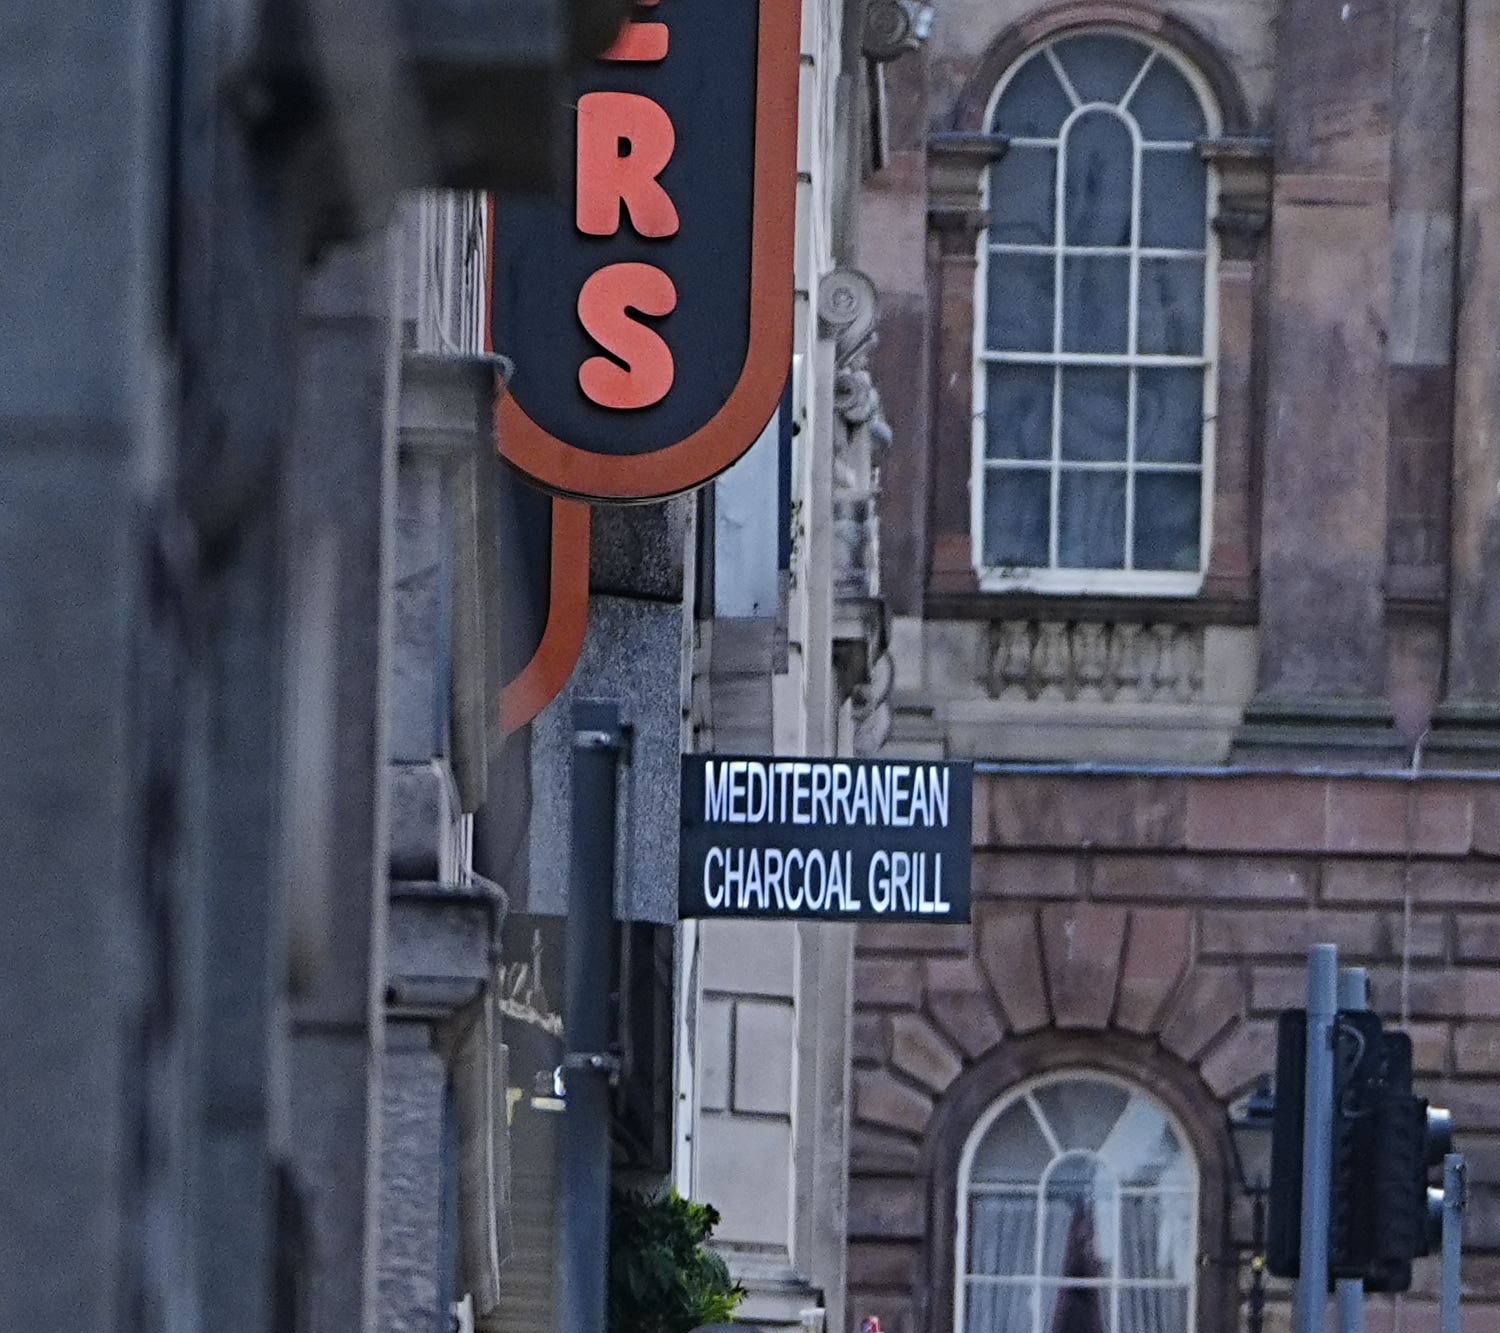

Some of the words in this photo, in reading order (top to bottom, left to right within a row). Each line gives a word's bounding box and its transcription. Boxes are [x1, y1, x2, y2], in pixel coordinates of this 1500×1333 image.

[576, 0, 680, 410] RS
[704, 760, 949, 827] MEDITERRANEAN
[703, 846, 861, 911] CHARCOAL
[867, 850, 950, 913] GRILL
